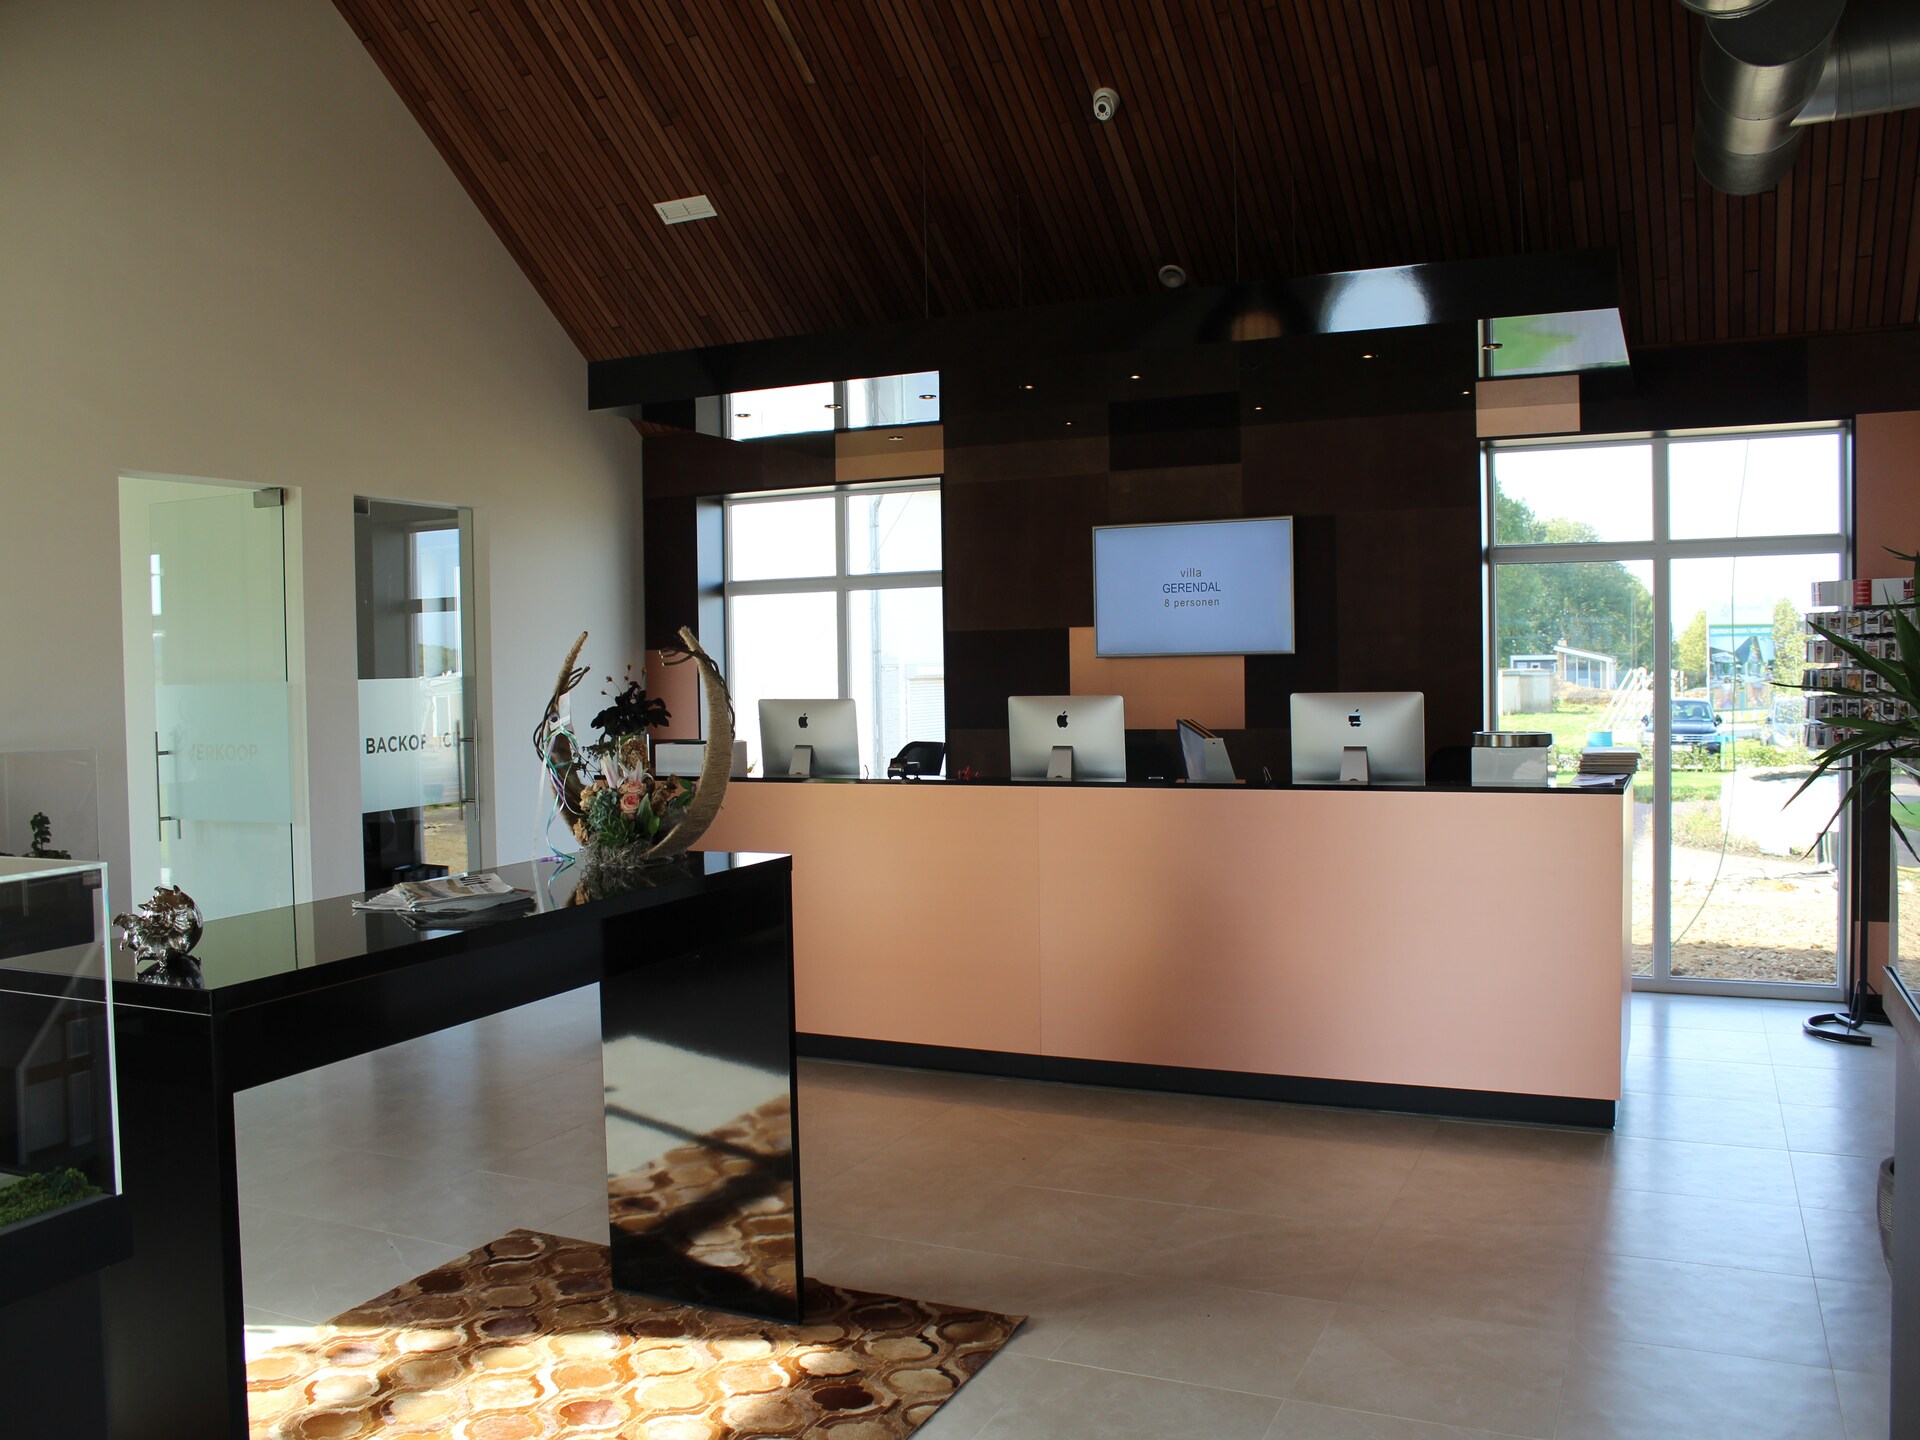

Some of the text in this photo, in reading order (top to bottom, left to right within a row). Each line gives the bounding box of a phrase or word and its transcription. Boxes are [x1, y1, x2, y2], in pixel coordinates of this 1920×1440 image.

[1180, 567, 1202, 577] villa
[1162, 581, 1221, 593] GERENDAL
[1164, 598, 1220, 609] 8 personen
